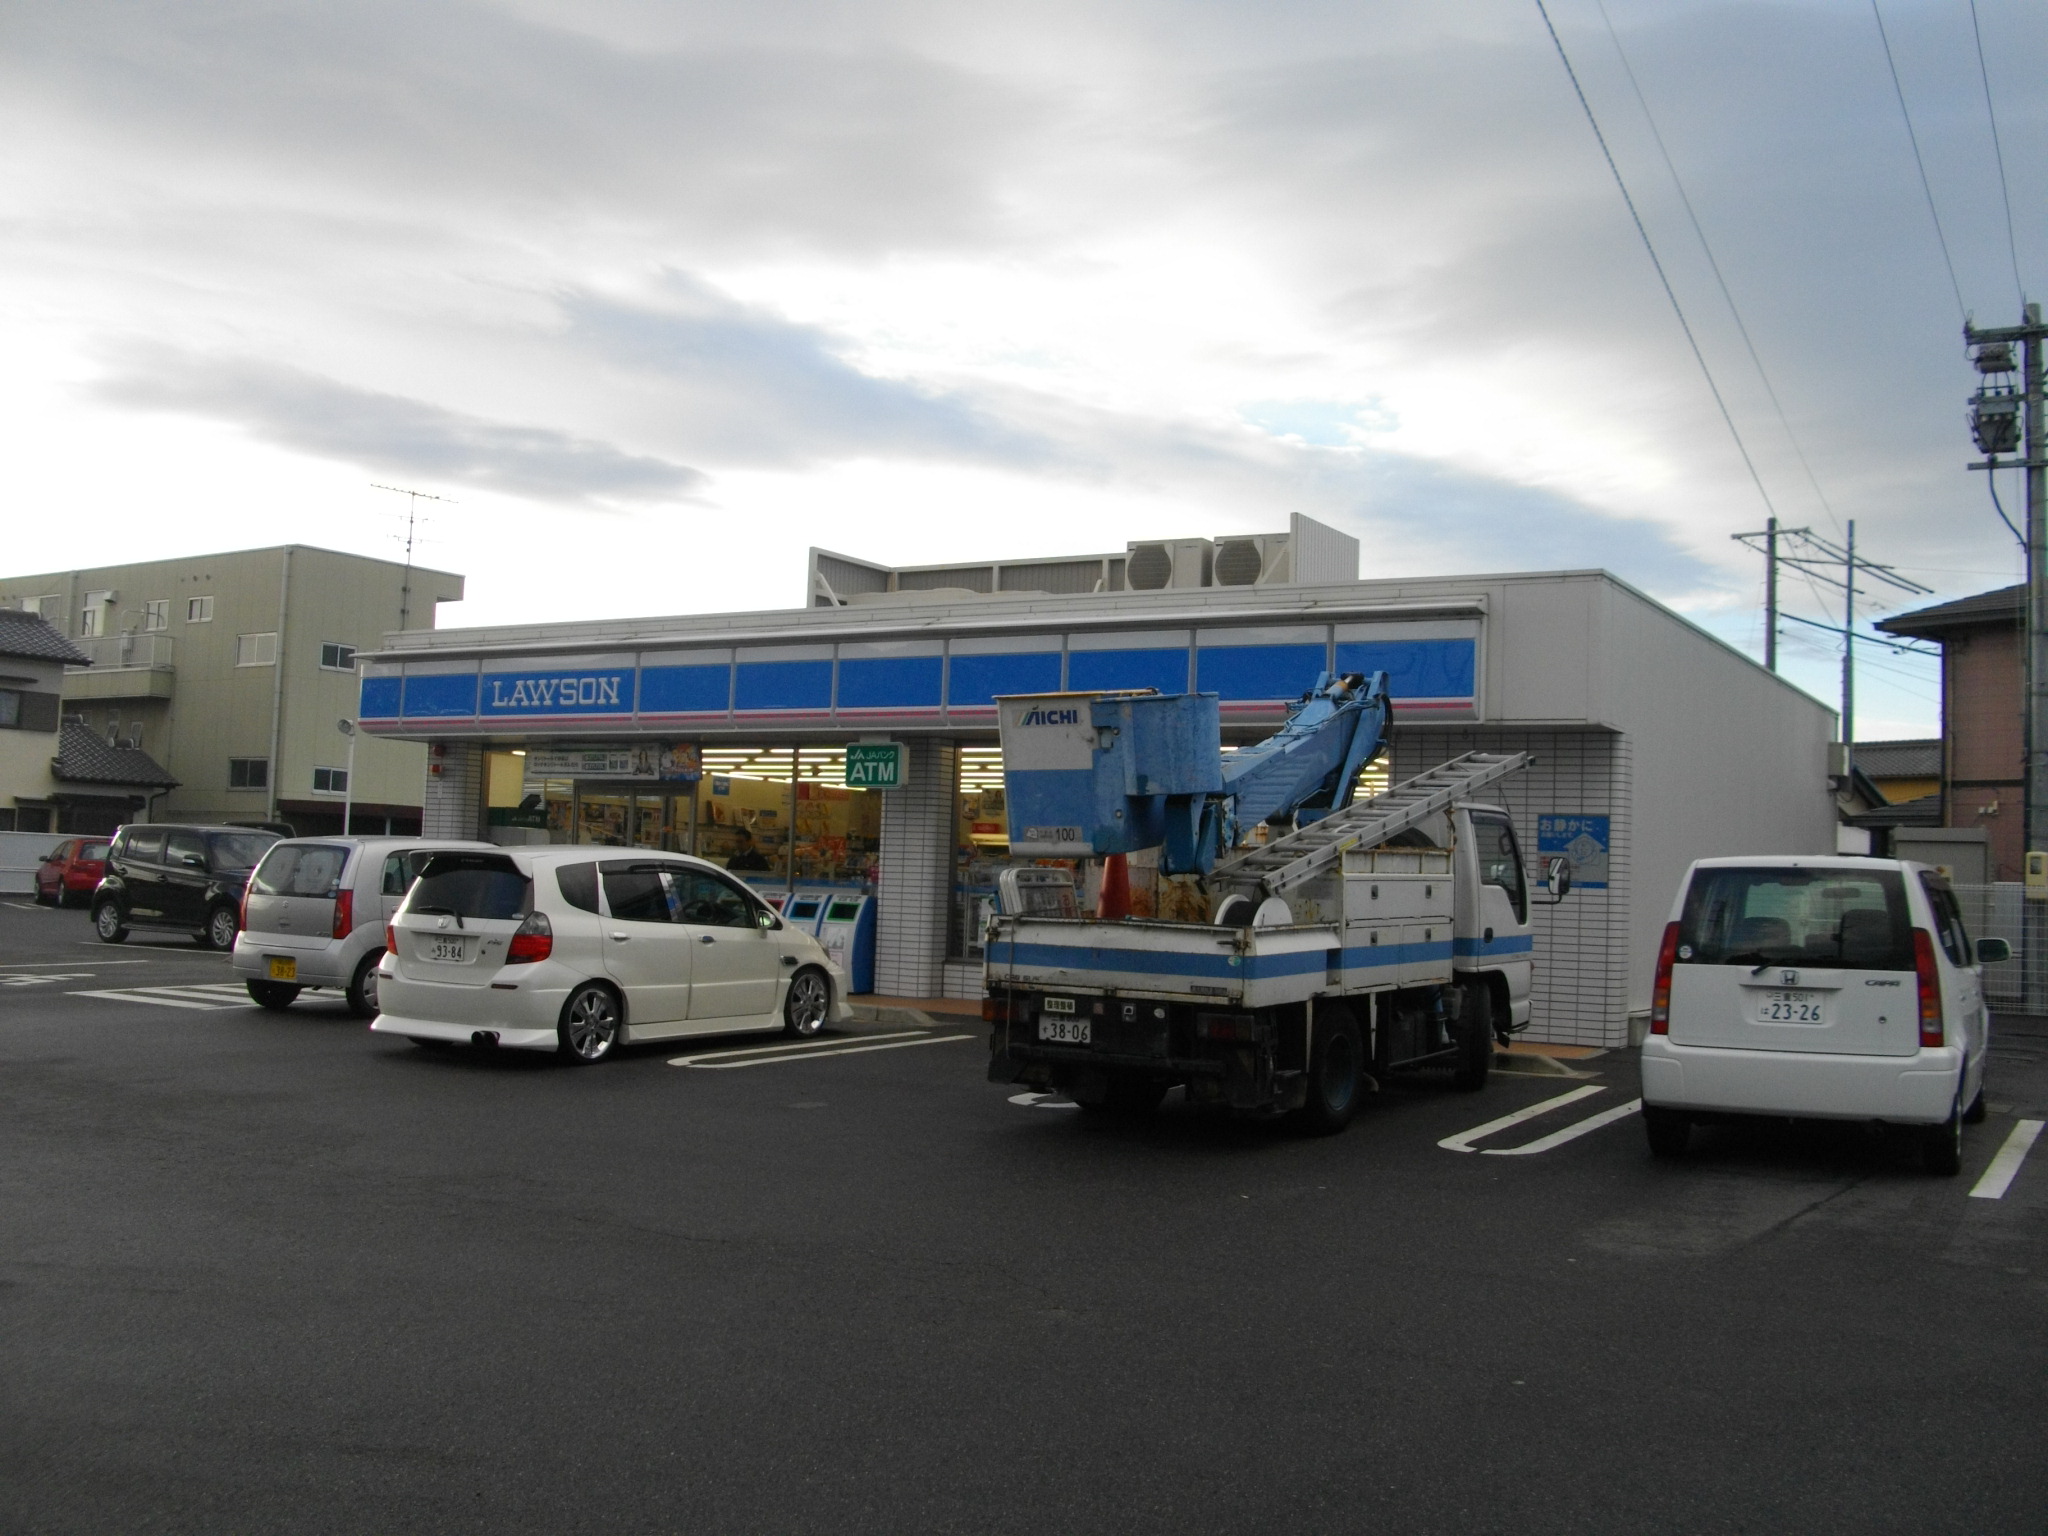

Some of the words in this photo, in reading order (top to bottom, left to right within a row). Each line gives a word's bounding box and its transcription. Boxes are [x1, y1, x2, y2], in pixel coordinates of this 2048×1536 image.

[492, 677, 621, 707] LAWSON
[1025, 709, 1078, 726] AICHI
[850, 761, 895, 782] ATM
[1056, 828, 1075, 841] 100
[436, 945, 462, 958] 93-84
[1771, 1003, 1821, 1021] 23-26
[1051, 1023, 1088, 1040] 38-06
